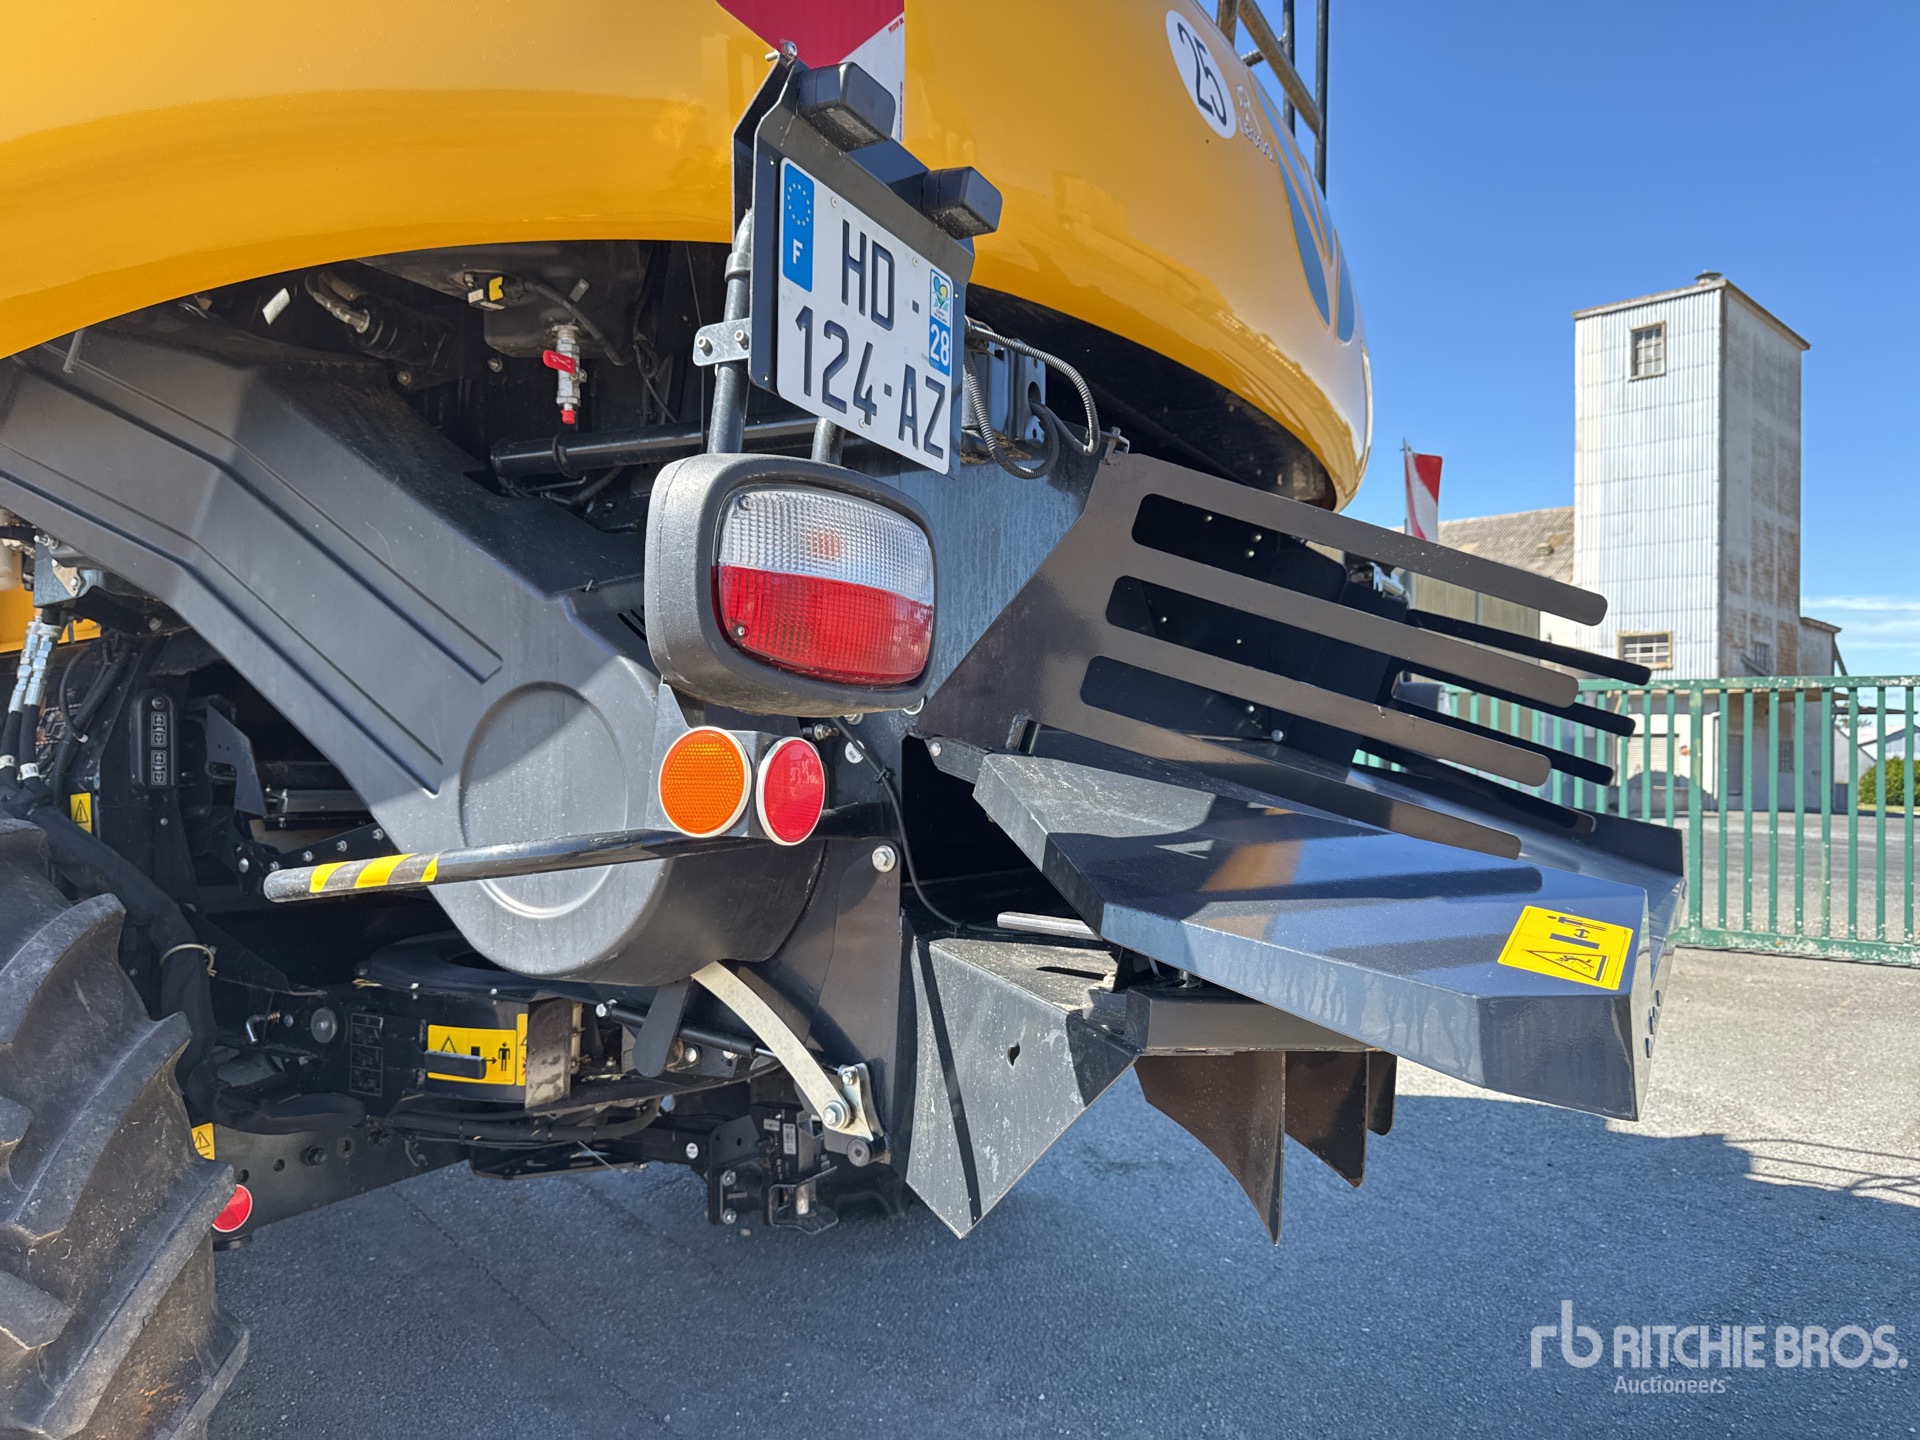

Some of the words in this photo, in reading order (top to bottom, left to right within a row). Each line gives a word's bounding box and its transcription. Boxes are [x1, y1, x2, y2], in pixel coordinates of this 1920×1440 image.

[1177, 22, 1227, 127] 25
[792, 238, 803, 264] F
[930, 323, 950, 367] 28
